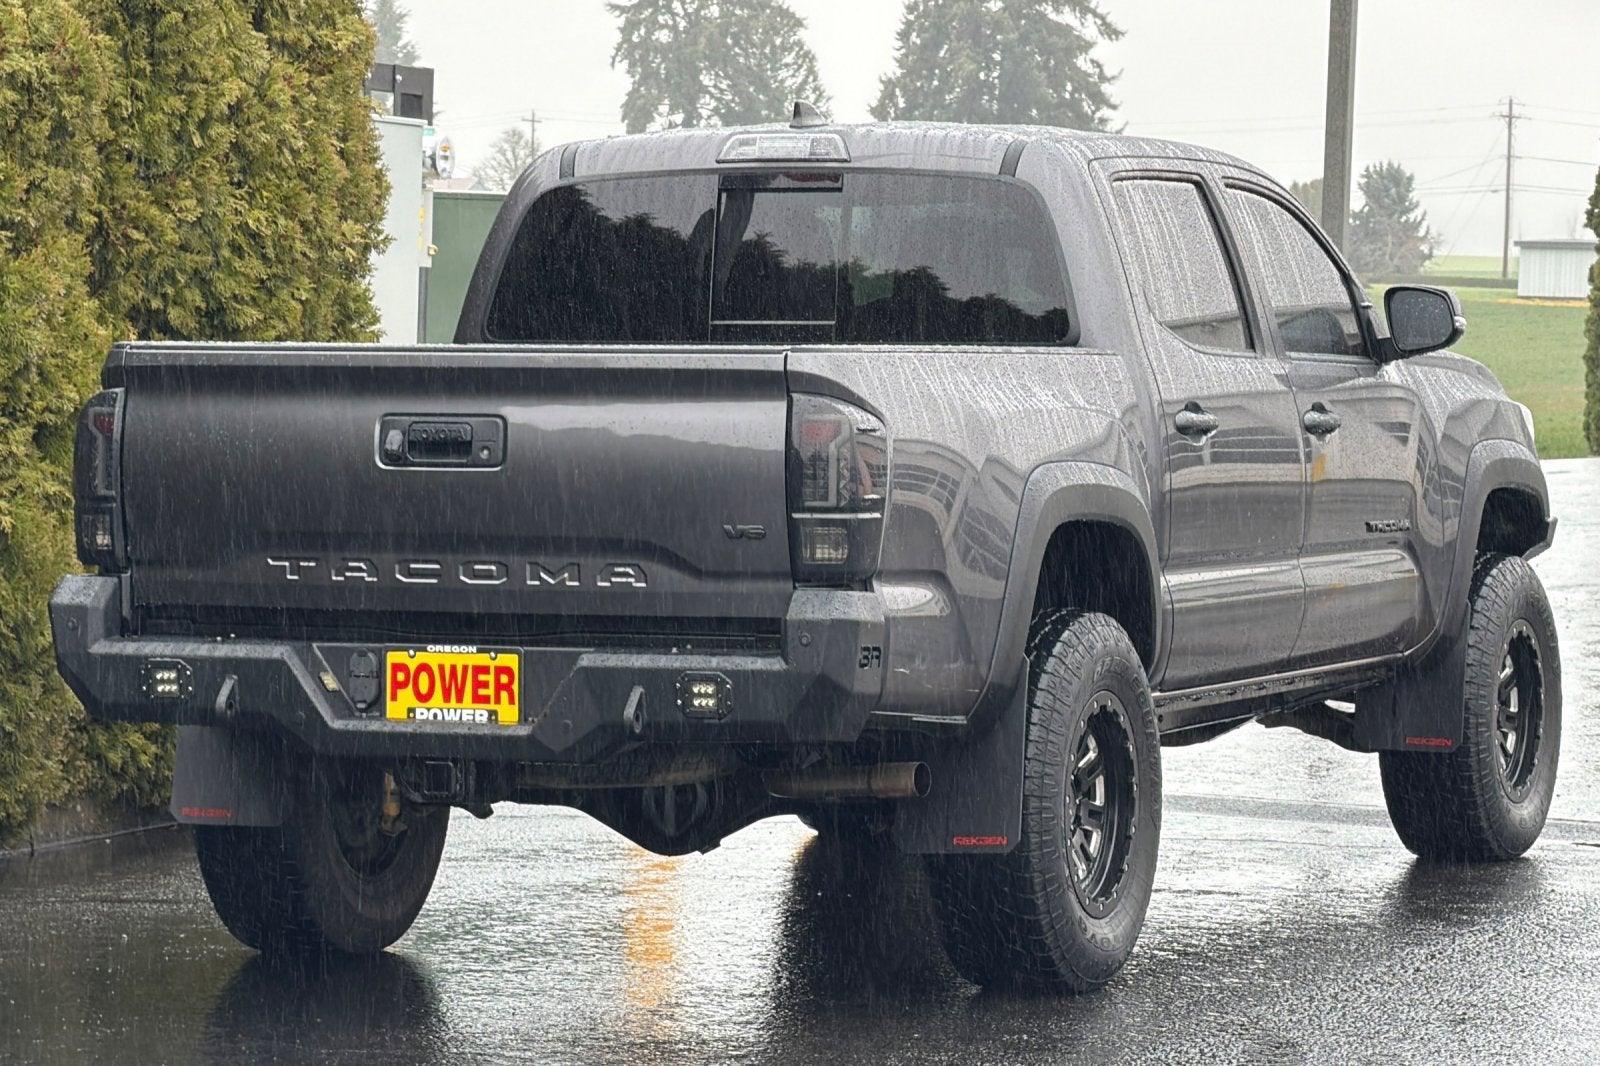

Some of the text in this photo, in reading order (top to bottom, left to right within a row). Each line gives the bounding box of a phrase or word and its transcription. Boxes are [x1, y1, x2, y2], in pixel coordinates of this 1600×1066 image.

[722, 524, 766, 540] V6
[266, 556, 648, 588] TACOMA
[426, 644, 478, 654] OREGON
[390, 662, 516, 706] POWER
[415, 707, 489, 723] POWER
